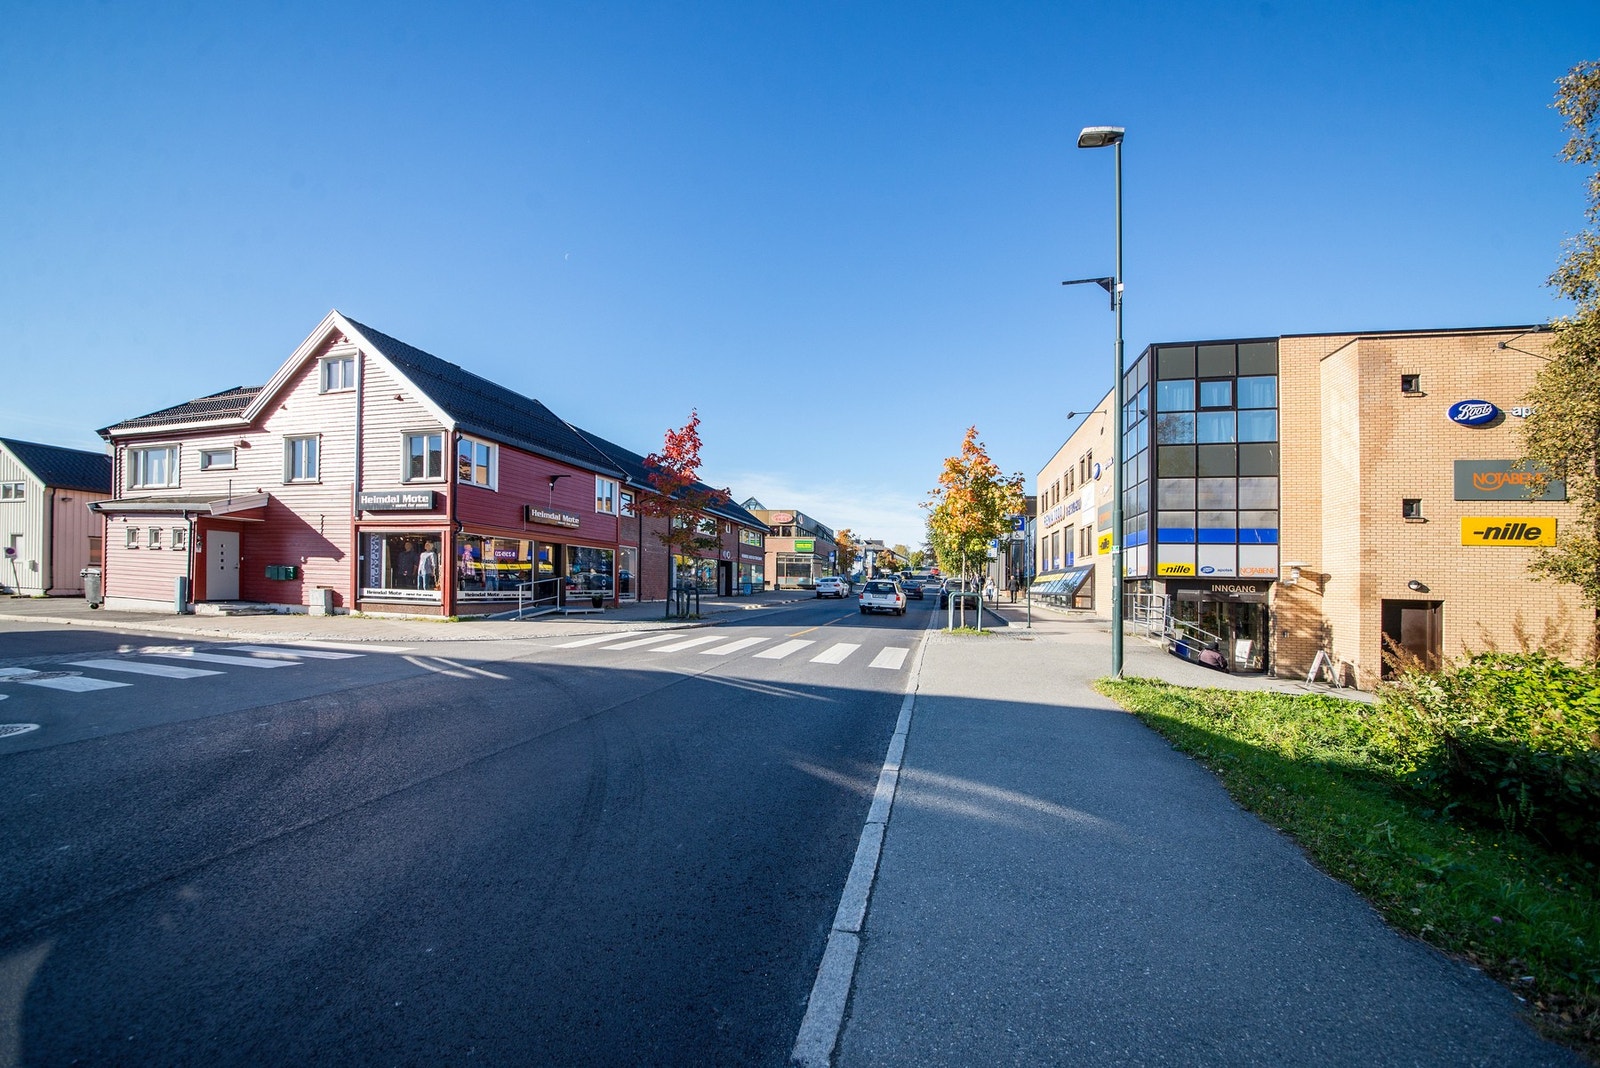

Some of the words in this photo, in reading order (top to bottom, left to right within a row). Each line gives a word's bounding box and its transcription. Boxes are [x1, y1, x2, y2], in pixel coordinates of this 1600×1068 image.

[1453, 403, 1493, 420] Boots
[361, 495, 400, 504] Heimdal
[402, 494, 429, 503] Mote
[531, 509, 561, 521] Heimdal
[562, 514, 580, 524] Mote
[1473, 523, 1542, 541] -nille
[1161, 565, 1191, 574] -nille
[1212, 584, 1256, 593] INNGANG
